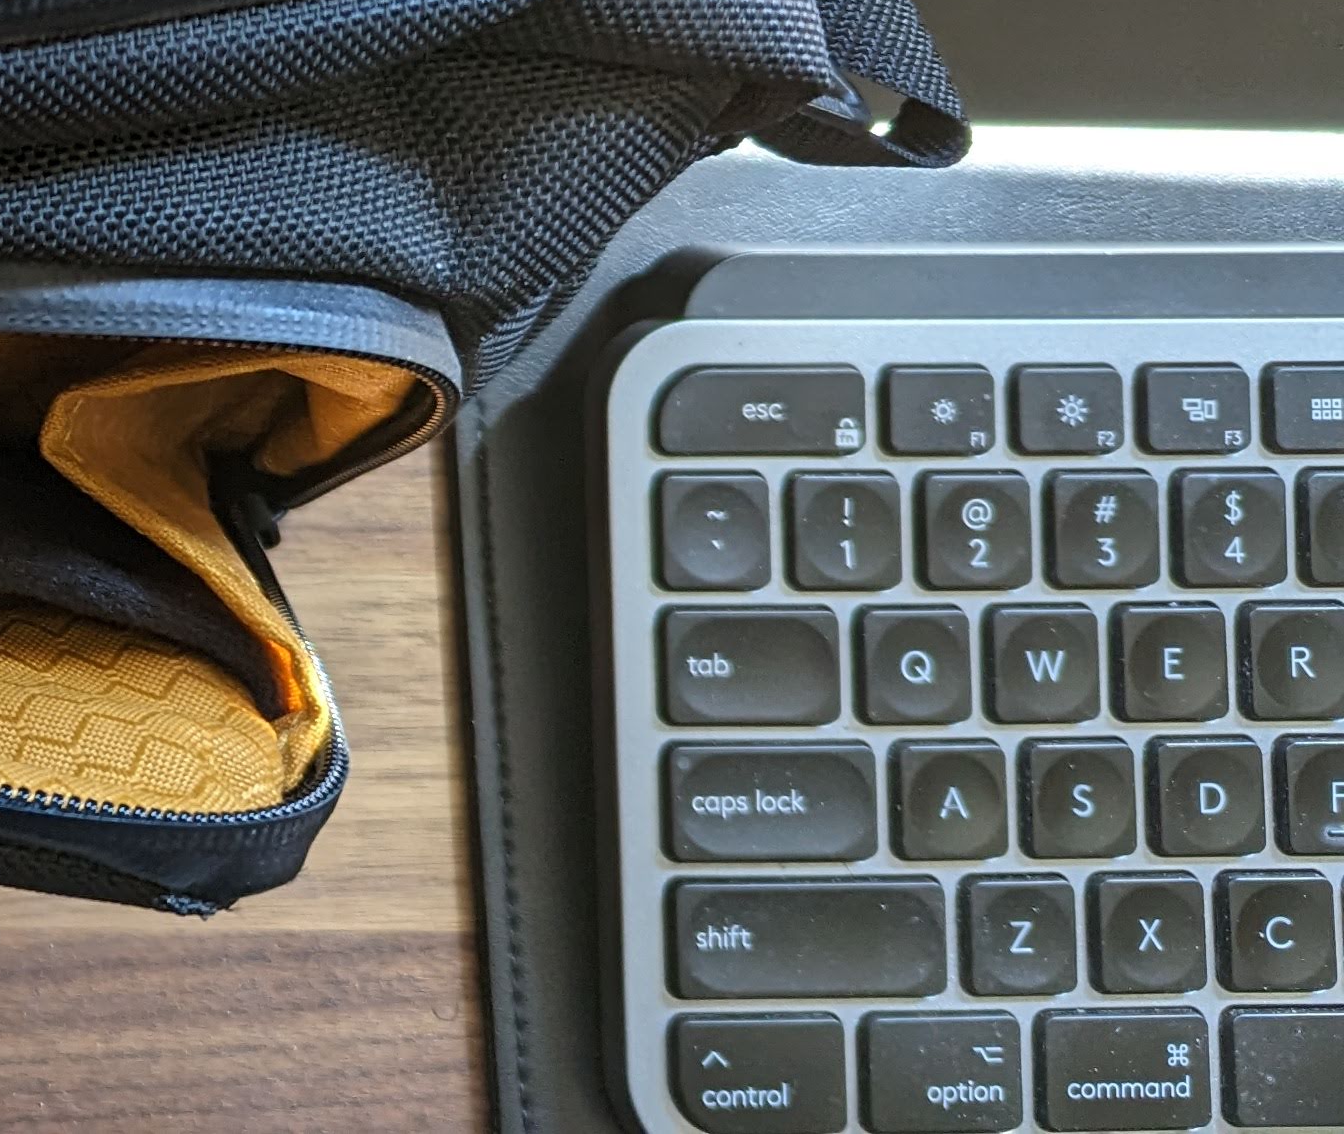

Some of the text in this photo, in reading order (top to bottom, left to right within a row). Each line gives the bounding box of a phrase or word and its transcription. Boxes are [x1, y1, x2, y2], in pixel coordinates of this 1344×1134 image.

[741, 402, 786, 422] esc
[838, 431, 854, 445] fn
[969, 431, 987, 448] F1
[1097, 431, 1116, 447] F2
[1223, 431, 1243, 446] F3
[843, 497, 854, 528] !
[961, 497, 994, 530] @
[1094, 496, 1117, 524] #
[1224, 490, 1244, 526] $
[840, 539, 856, 569] 1
[968, 538, 990, 568] 2
[1096, 538, 1117, 567] 3
[1223, 536, 1245, 565] 4
[686, 652, 733, 678] tab
[900, 650, 933, 684] Q
[1025, 650, 1065, 682] W
[1162, 647, 1185, 680] E
[1290, 647, 1316, 678] R
[691, 788, 805, 819] caps lock
[940, 786, 969, 819] A
[1071, 784, 1095, 819] S
[1200, 782, 1227, 815] D
[696, 925, 752, 951] shift
[1010, 921, 1035, 954] Z
[1137, 918, 1165, 952] X
[1265, 916, 1294, 949] C
[701, 1082, 789, 1109] control
[926, 1080, 1005, 1108] option
[1066, 1075, 1191, 1100] command
